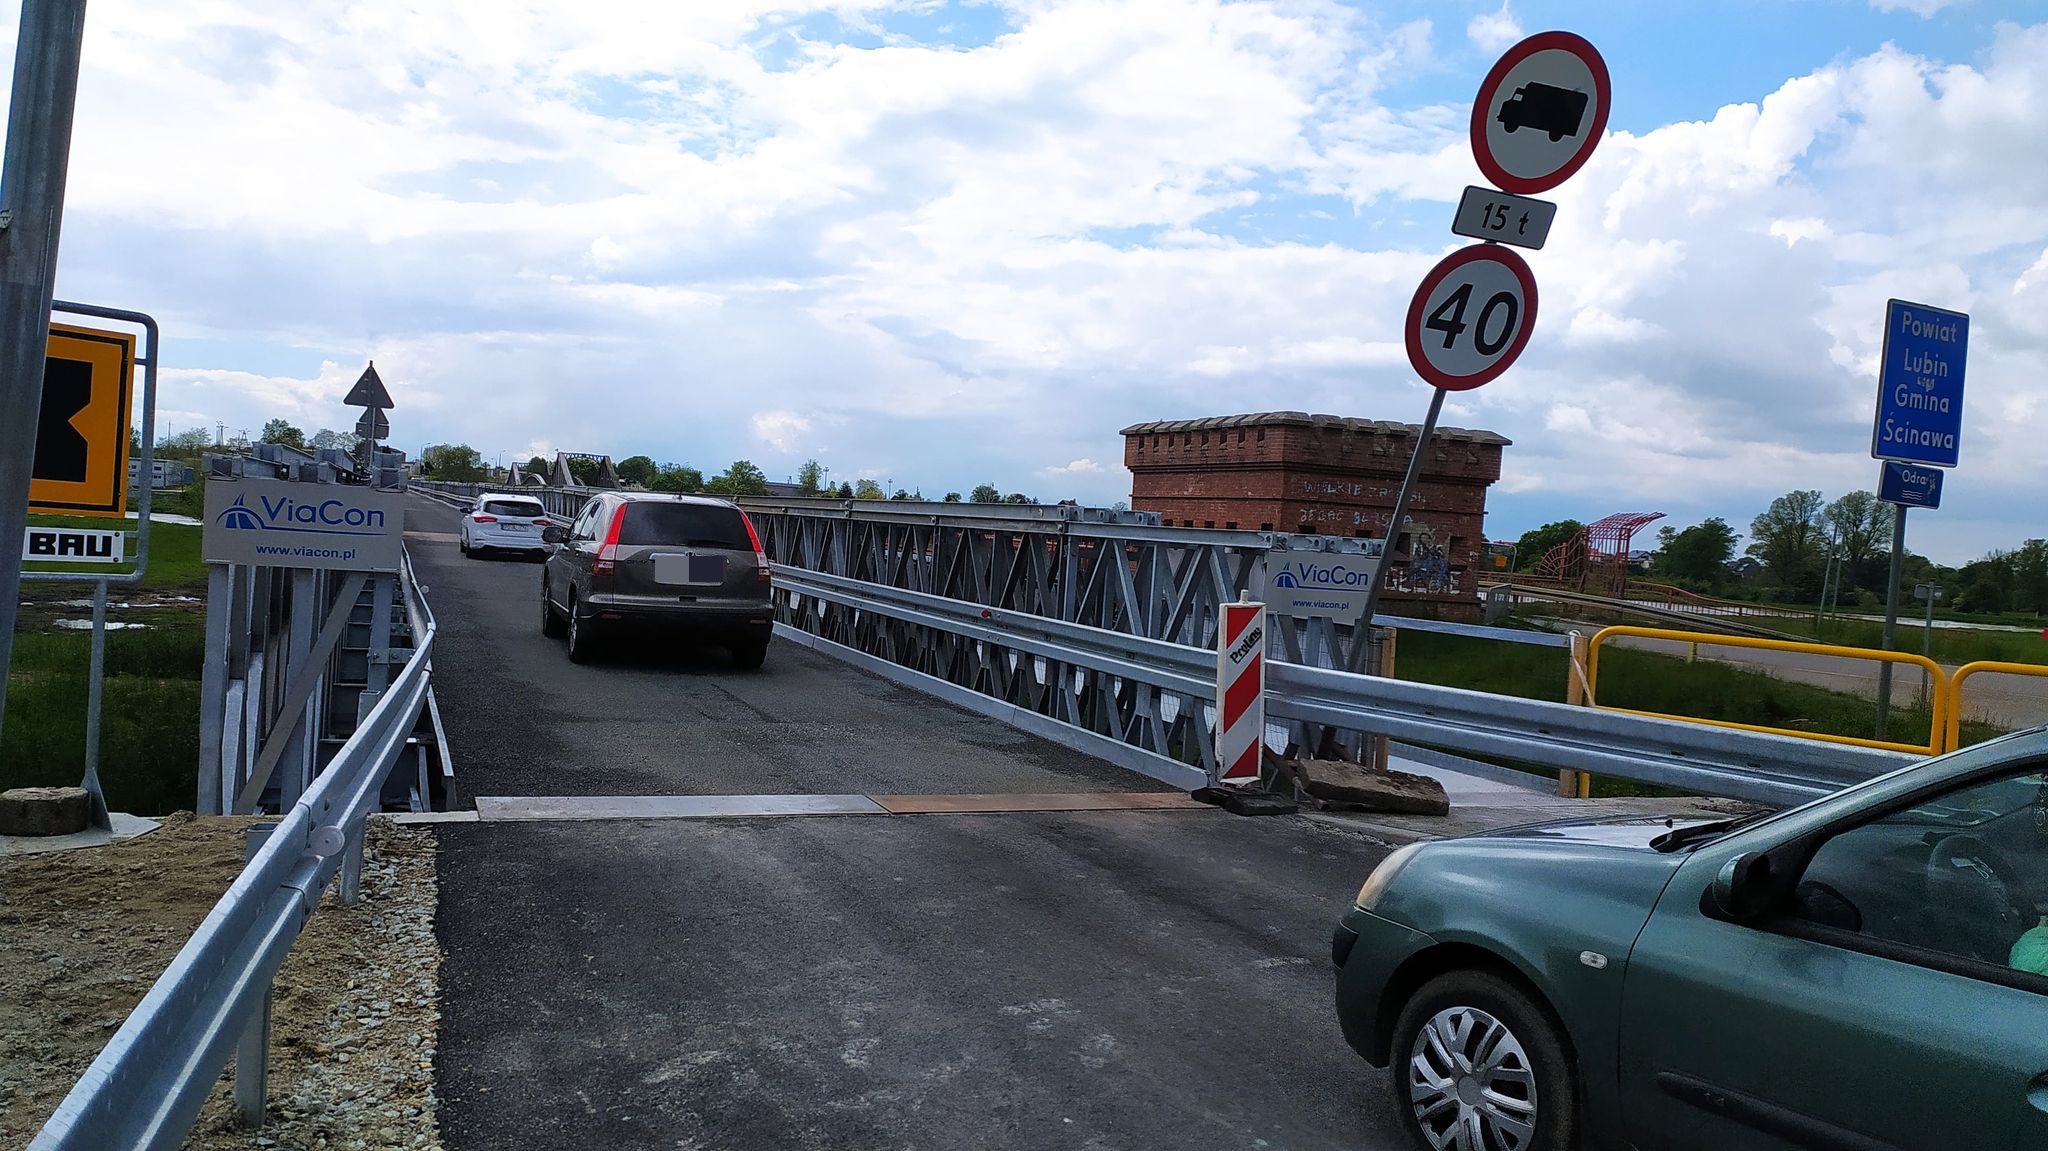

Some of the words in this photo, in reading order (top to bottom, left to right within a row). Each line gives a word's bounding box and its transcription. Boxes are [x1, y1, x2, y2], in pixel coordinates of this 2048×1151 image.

[1481, 202, 1511, 231] 15
[1518, 210, 1529, 236] t
[1425, 283, 1518, 356] 40
[1902, 311, 1957, 343] Powiat
[1903, 348, 1948, 377] Lubin
[1895, 383, 1950, 413] Gmina
[1883, 411, 1954, 449] Ścinawa
[1902, 470, 1927, 485] Odra
[260, 495, 385, 527] ViaCon
[29, 532, 112, 557] BAU
[256, 545, 356, 561] www.viacon.pl
[1299, 562, 1369, 586] ViaCon
[1292, 599, 1350, 611] www.viacon.pl
